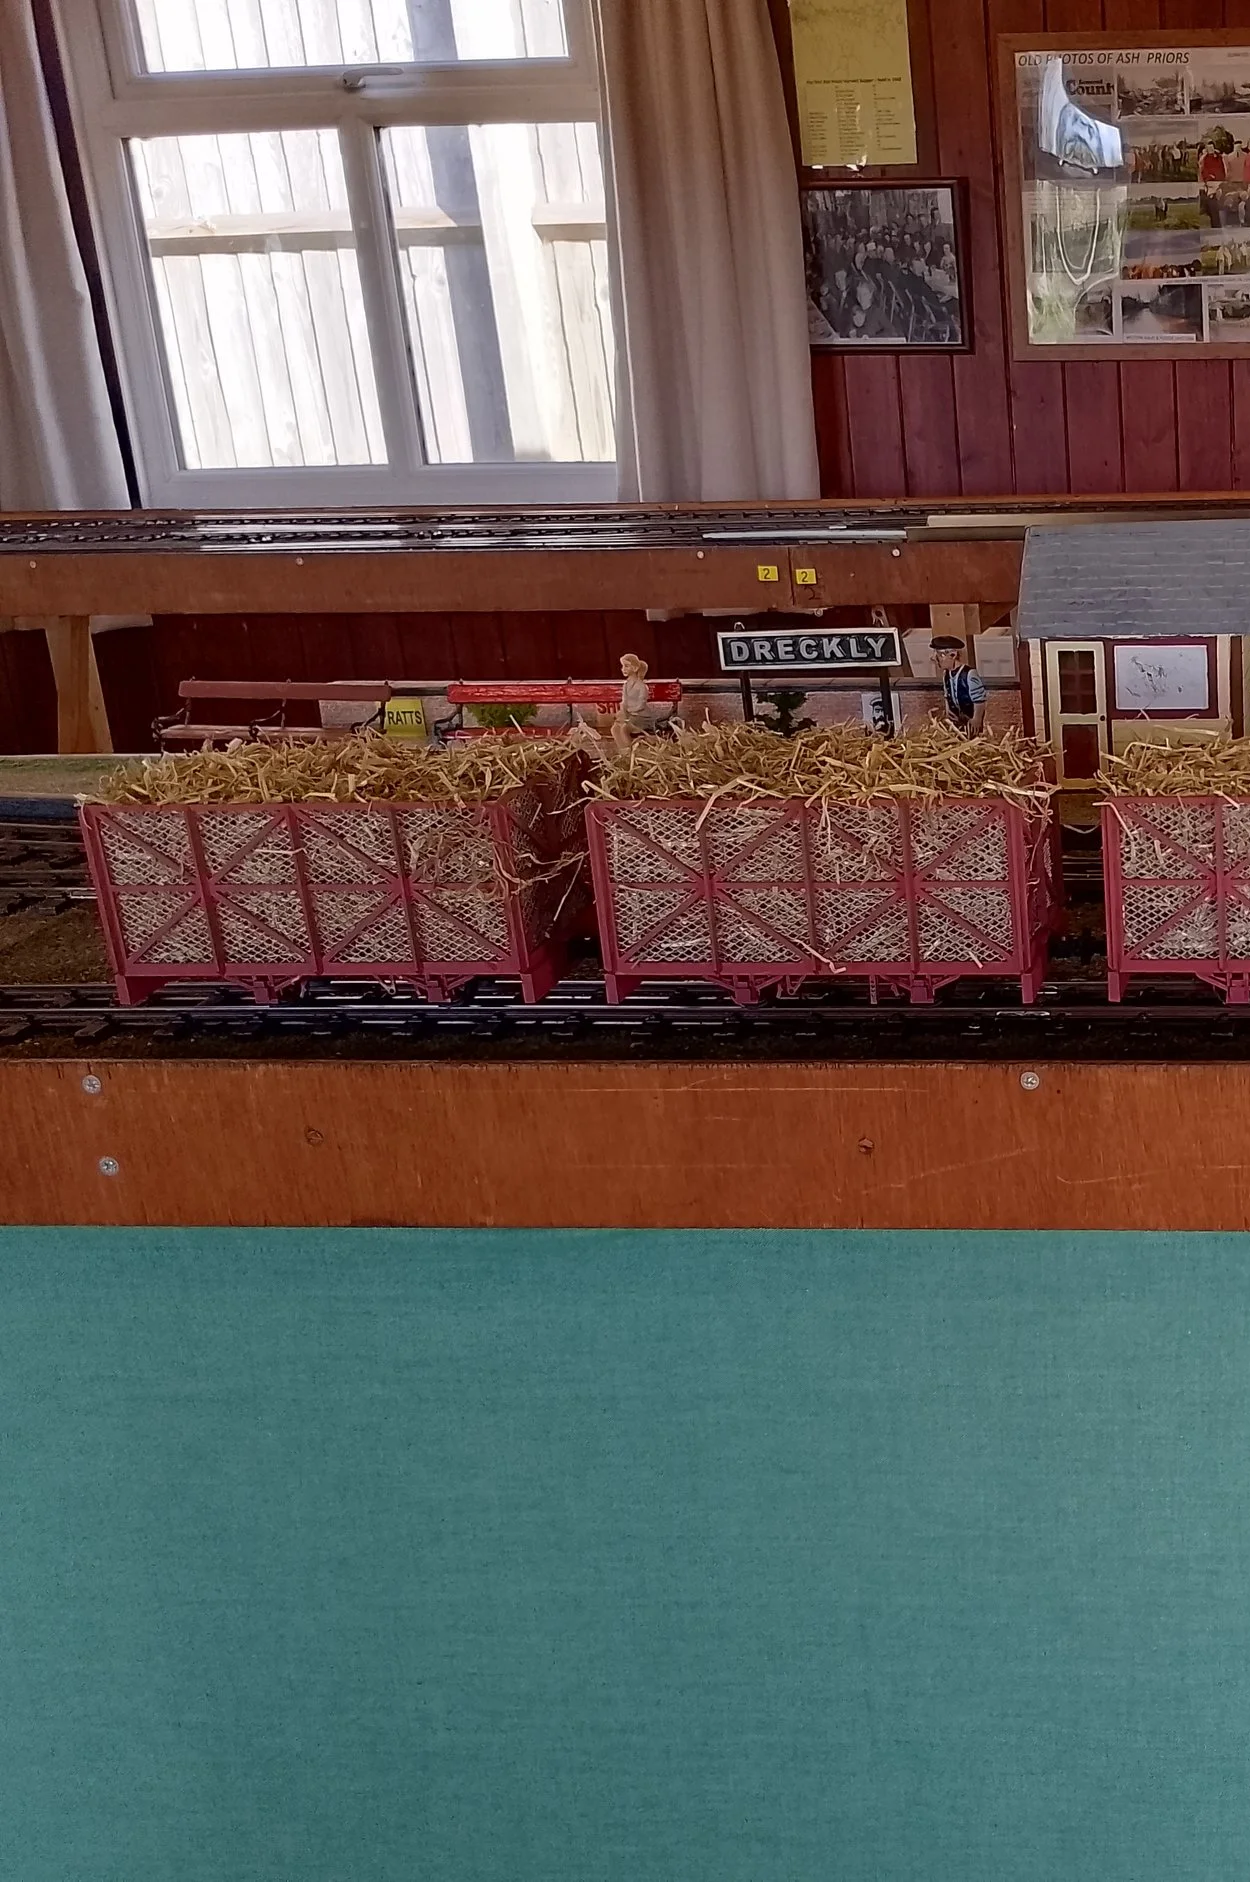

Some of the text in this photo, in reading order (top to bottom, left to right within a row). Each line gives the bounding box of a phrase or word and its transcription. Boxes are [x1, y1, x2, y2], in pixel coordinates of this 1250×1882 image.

[1018, 52, 1190, 66] OLD POTOS OF ASH PRIORS
[763, 567, 771, 580] 2
[801, 570, 809, 583] 2
[729, 637, 886, 662] DRECKLY
[387, 710, 423, 725] RATTS
